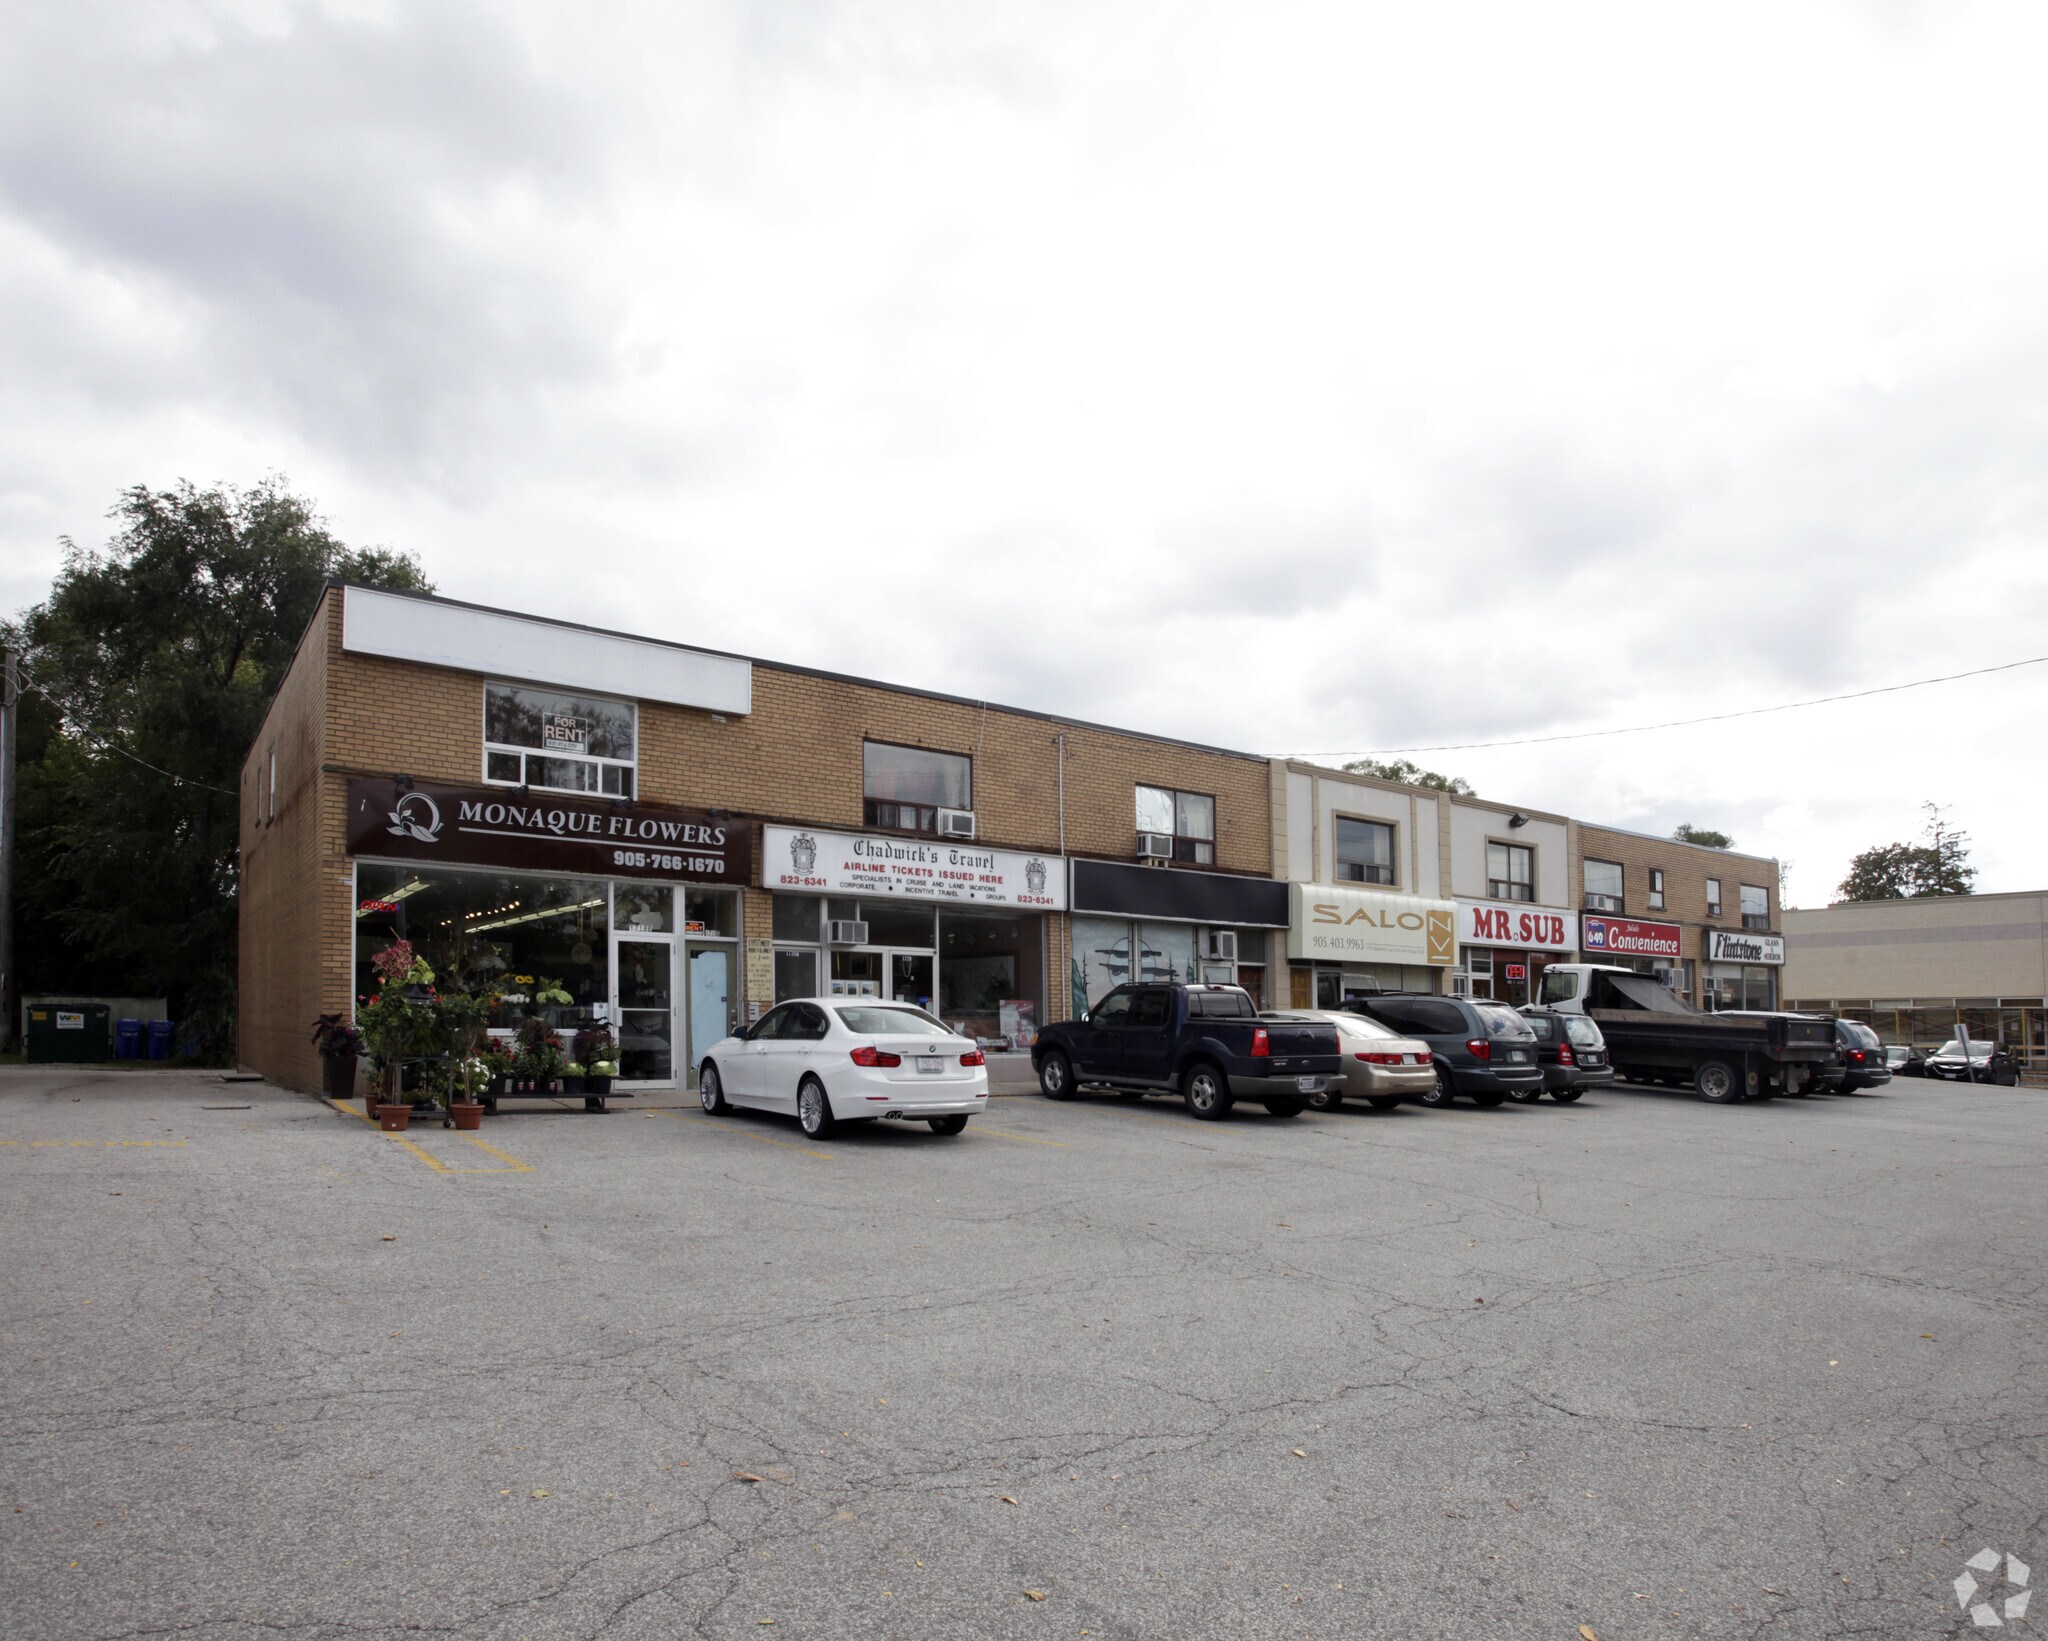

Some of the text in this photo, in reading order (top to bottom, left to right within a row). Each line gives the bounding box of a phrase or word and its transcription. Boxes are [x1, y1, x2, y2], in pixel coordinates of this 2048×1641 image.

[554, 716, 576, 728] FOR
[544, 725, 585, 742] RENT
[458, 800, 726, 846] MONAQUE FLOWERS
[853, 839, 995, 872] Chadwick's Travel
[780, 874, 828, 887] 823-6341
[843, 862, 1004, 884] AIRLINE TICKETS ISSUED HERE
[839, 881, 876, 891] CORPORATE
[905, 887, 935, 895] INCENTIVE
[986, 893, 1007, 901] GROUPS
[852, 874, 892, 883] SPECIALISTS
[906, 878, 927, 887] CRUISE
[969, 885, 996, 893] VACATIONS
[360, 899, 397, 912] OPEN
[1017, 894, 1054, 905] 823-6341
[1312, 935, 1365, 950] 905.403.9963
[1588, 930, 1604, 944] 649
[1609, 926, 1678, 953] Convenience
[1764, 939, 1779, 947] GLASS
[1714, 933, 1763, 961] Flintstone
[1763, 953, 1781, 961] MIRROR
